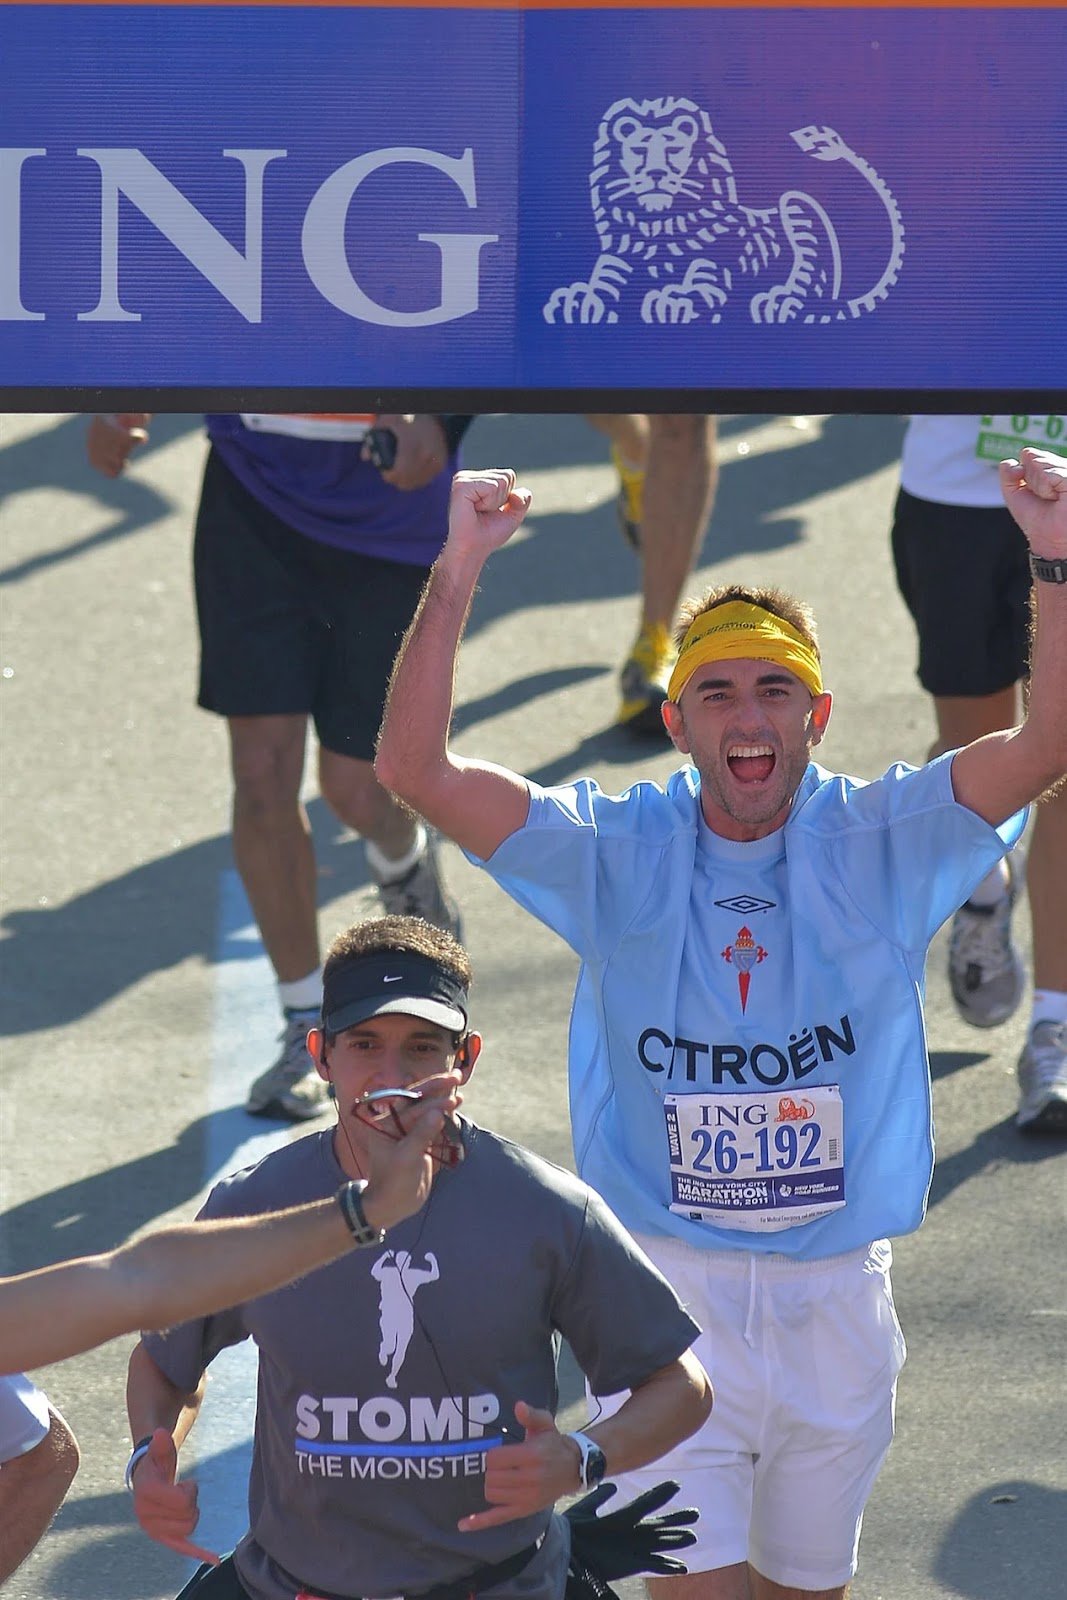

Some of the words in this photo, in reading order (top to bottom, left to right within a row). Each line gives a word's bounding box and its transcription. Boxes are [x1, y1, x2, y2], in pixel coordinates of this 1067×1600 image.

[0, 147, 499, 327] ING
[666, 1113, 676, 1122] 2
[699, 1103, 769, 1127] ING
[667, 1124, 680, 1156] WAVE
[691, 1122, 822, 1174] 26-192
[677, 1177, 691, 1185] THE
[692, 1179, 705, 1188] ING
[677, 1183, 768, 1199] MARATHON
[678, 1193, 731, 1205] NOVEMBER
[745, 1197, 769, 1206] 2011
[296, 1393, 500, 1442] STOMP
[295, 1450, 343, 1478] THE
